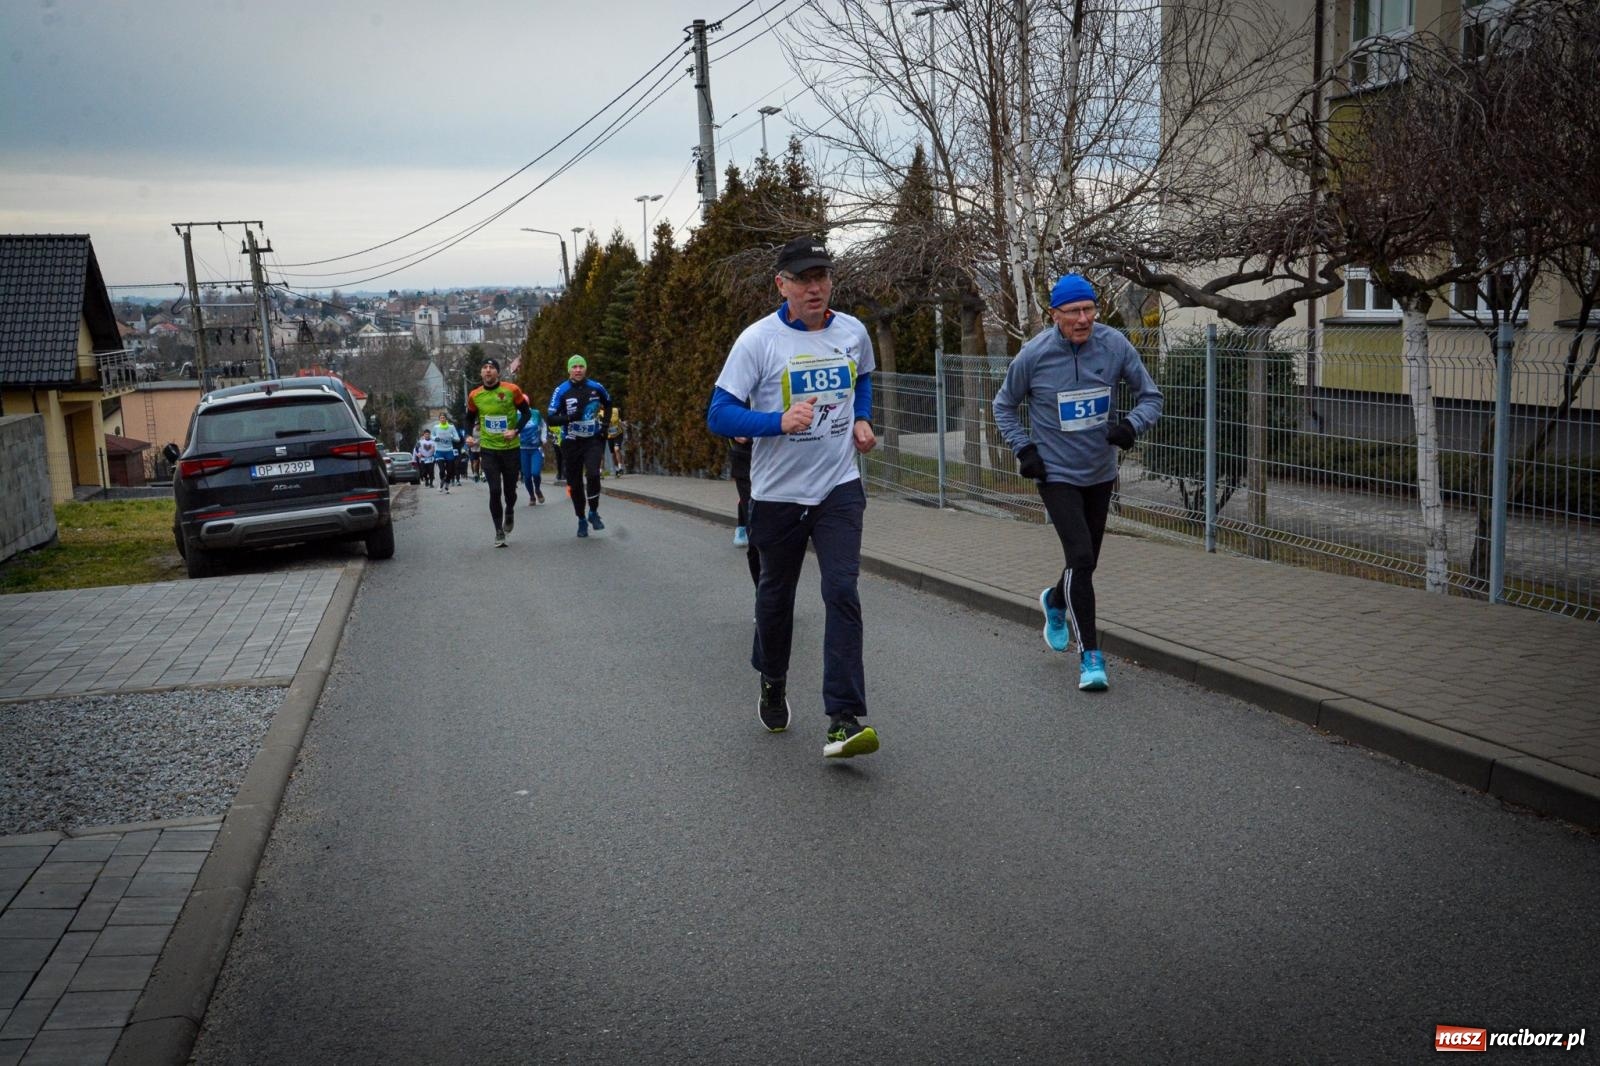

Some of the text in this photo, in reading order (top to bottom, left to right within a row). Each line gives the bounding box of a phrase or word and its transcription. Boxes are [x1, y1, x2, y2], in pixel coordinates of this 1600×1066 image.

[802, 368, 841, 392] 185
[1075, 400, 1097, 417] 51
[490, 421, 502, 430] 82
[258, 462, 311, 476] OP 1239P
